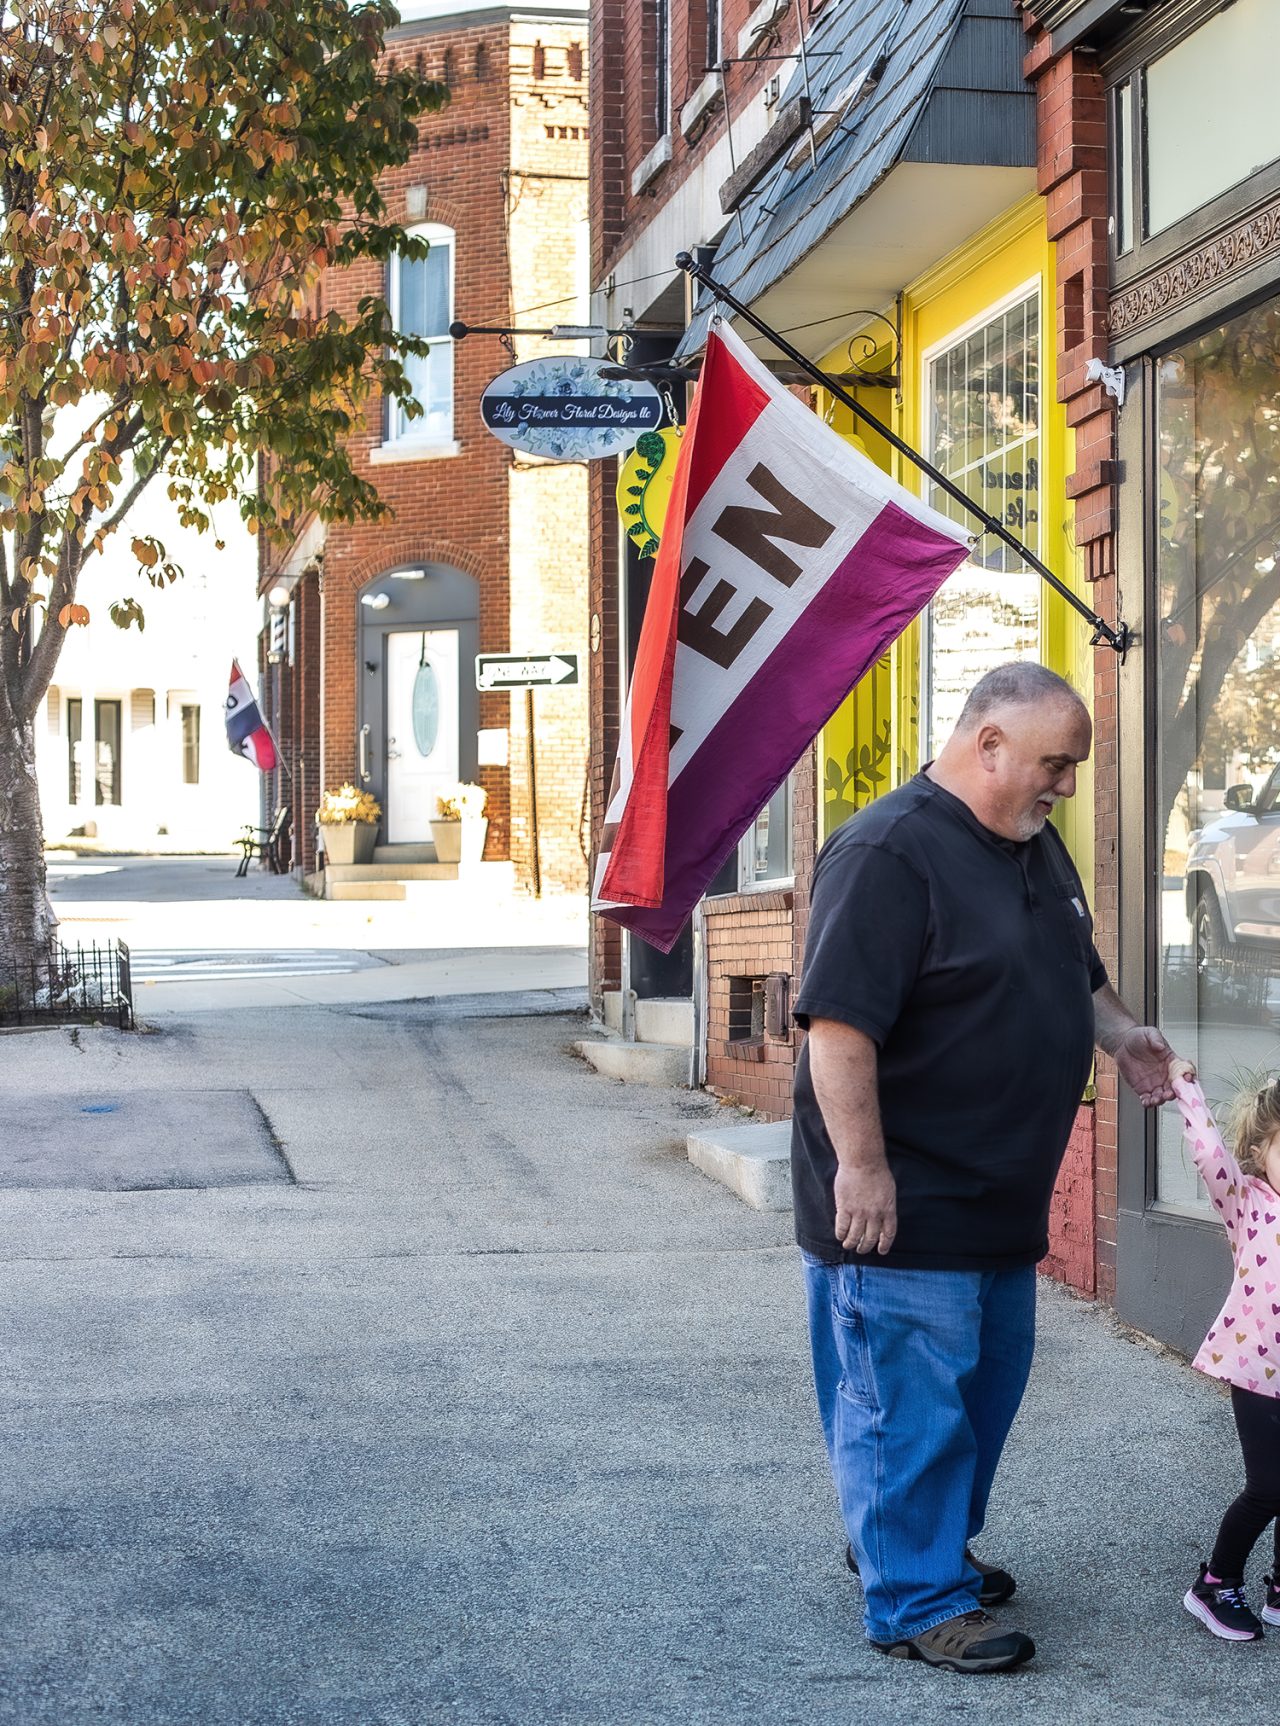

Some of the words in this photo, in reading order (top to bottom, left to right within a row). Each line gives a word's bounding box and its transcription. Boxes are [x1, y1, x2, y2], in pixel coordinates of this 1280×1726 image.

[492, 402, 515, 423] Lily
[518, 403, 558, 419] Flower
[561, 403, 596, 419] Floral
[598, 404, 637, 423] Designs
